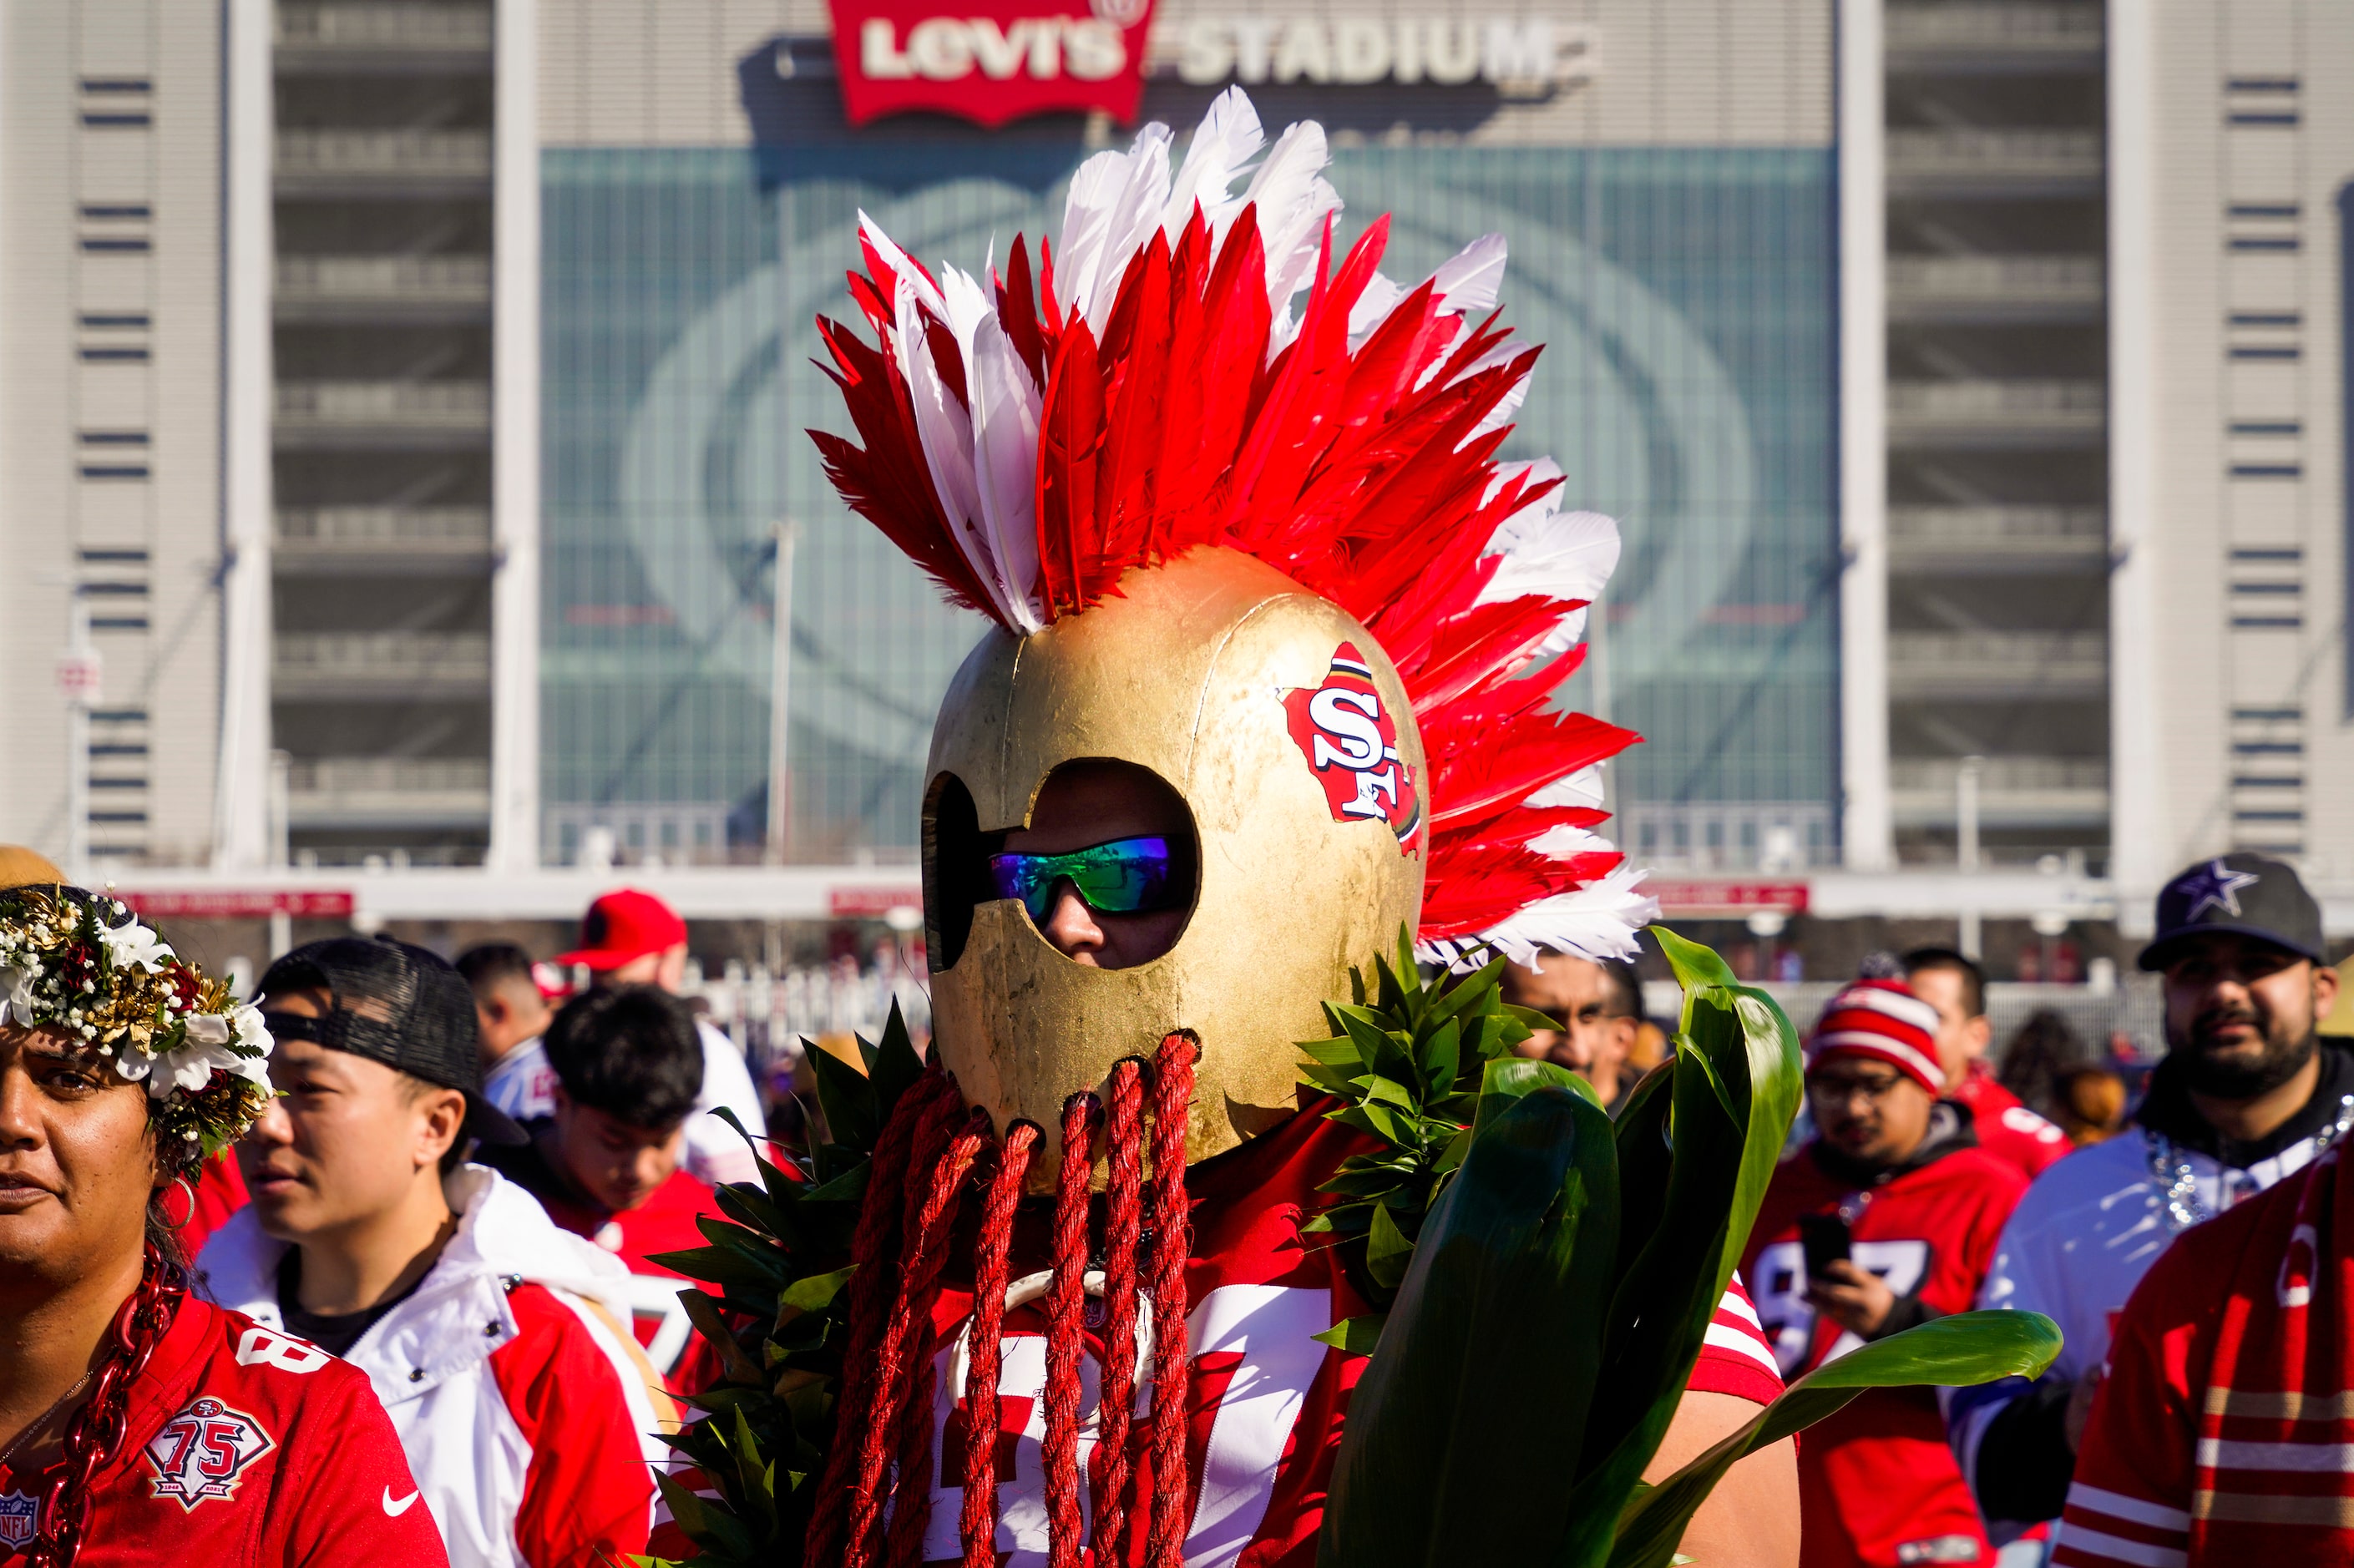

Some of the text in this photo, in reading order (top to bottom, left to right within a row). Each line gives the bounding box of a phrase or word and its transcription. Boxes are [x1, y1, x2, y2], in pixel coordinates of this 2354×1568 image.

[1177, 17, 1553, 83] STADIUM
[162, 1420, 246, 1481] 75
[1, 1515, 31, 1540] NFL
